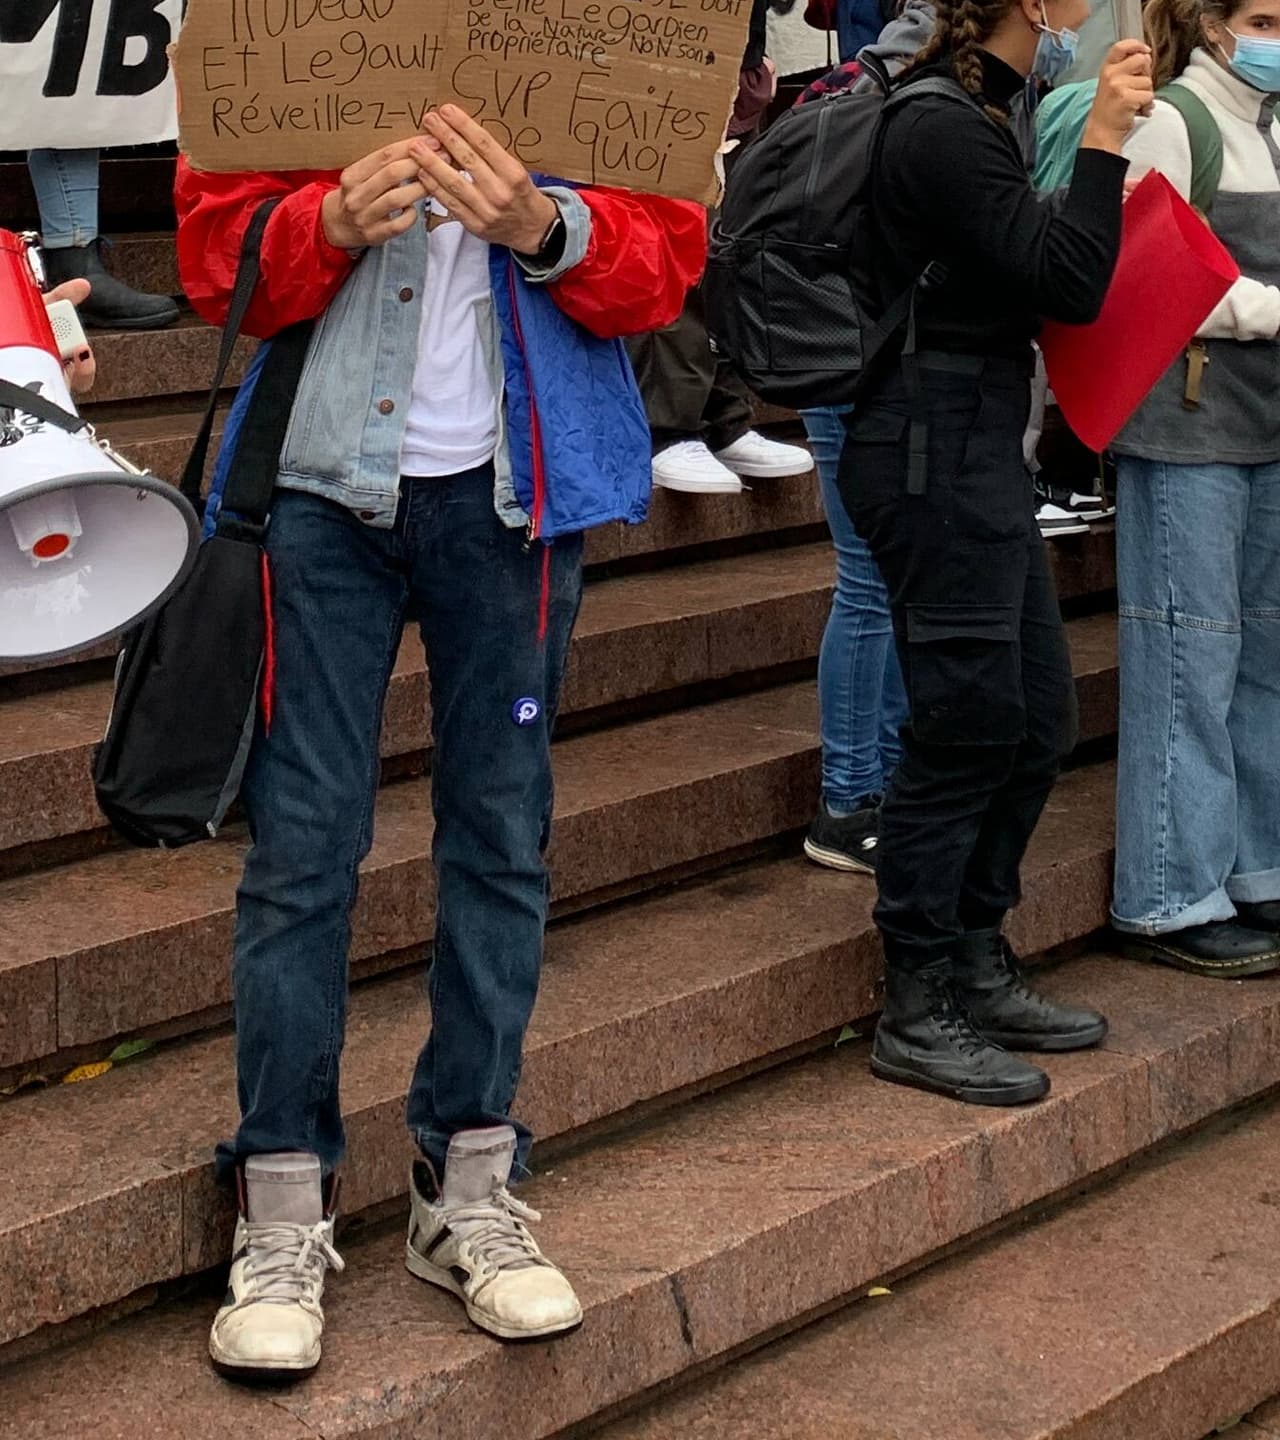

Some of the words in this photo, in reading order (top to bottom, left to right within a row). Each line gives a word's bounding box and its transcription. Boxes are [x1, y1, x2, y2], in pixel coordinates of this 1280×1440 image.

[202, 44, 260, 92] Et
[451, 54, 553, 119] SVP
[568, 70, 711, 142] Faites
[573, 120, 673, 185] quoi
